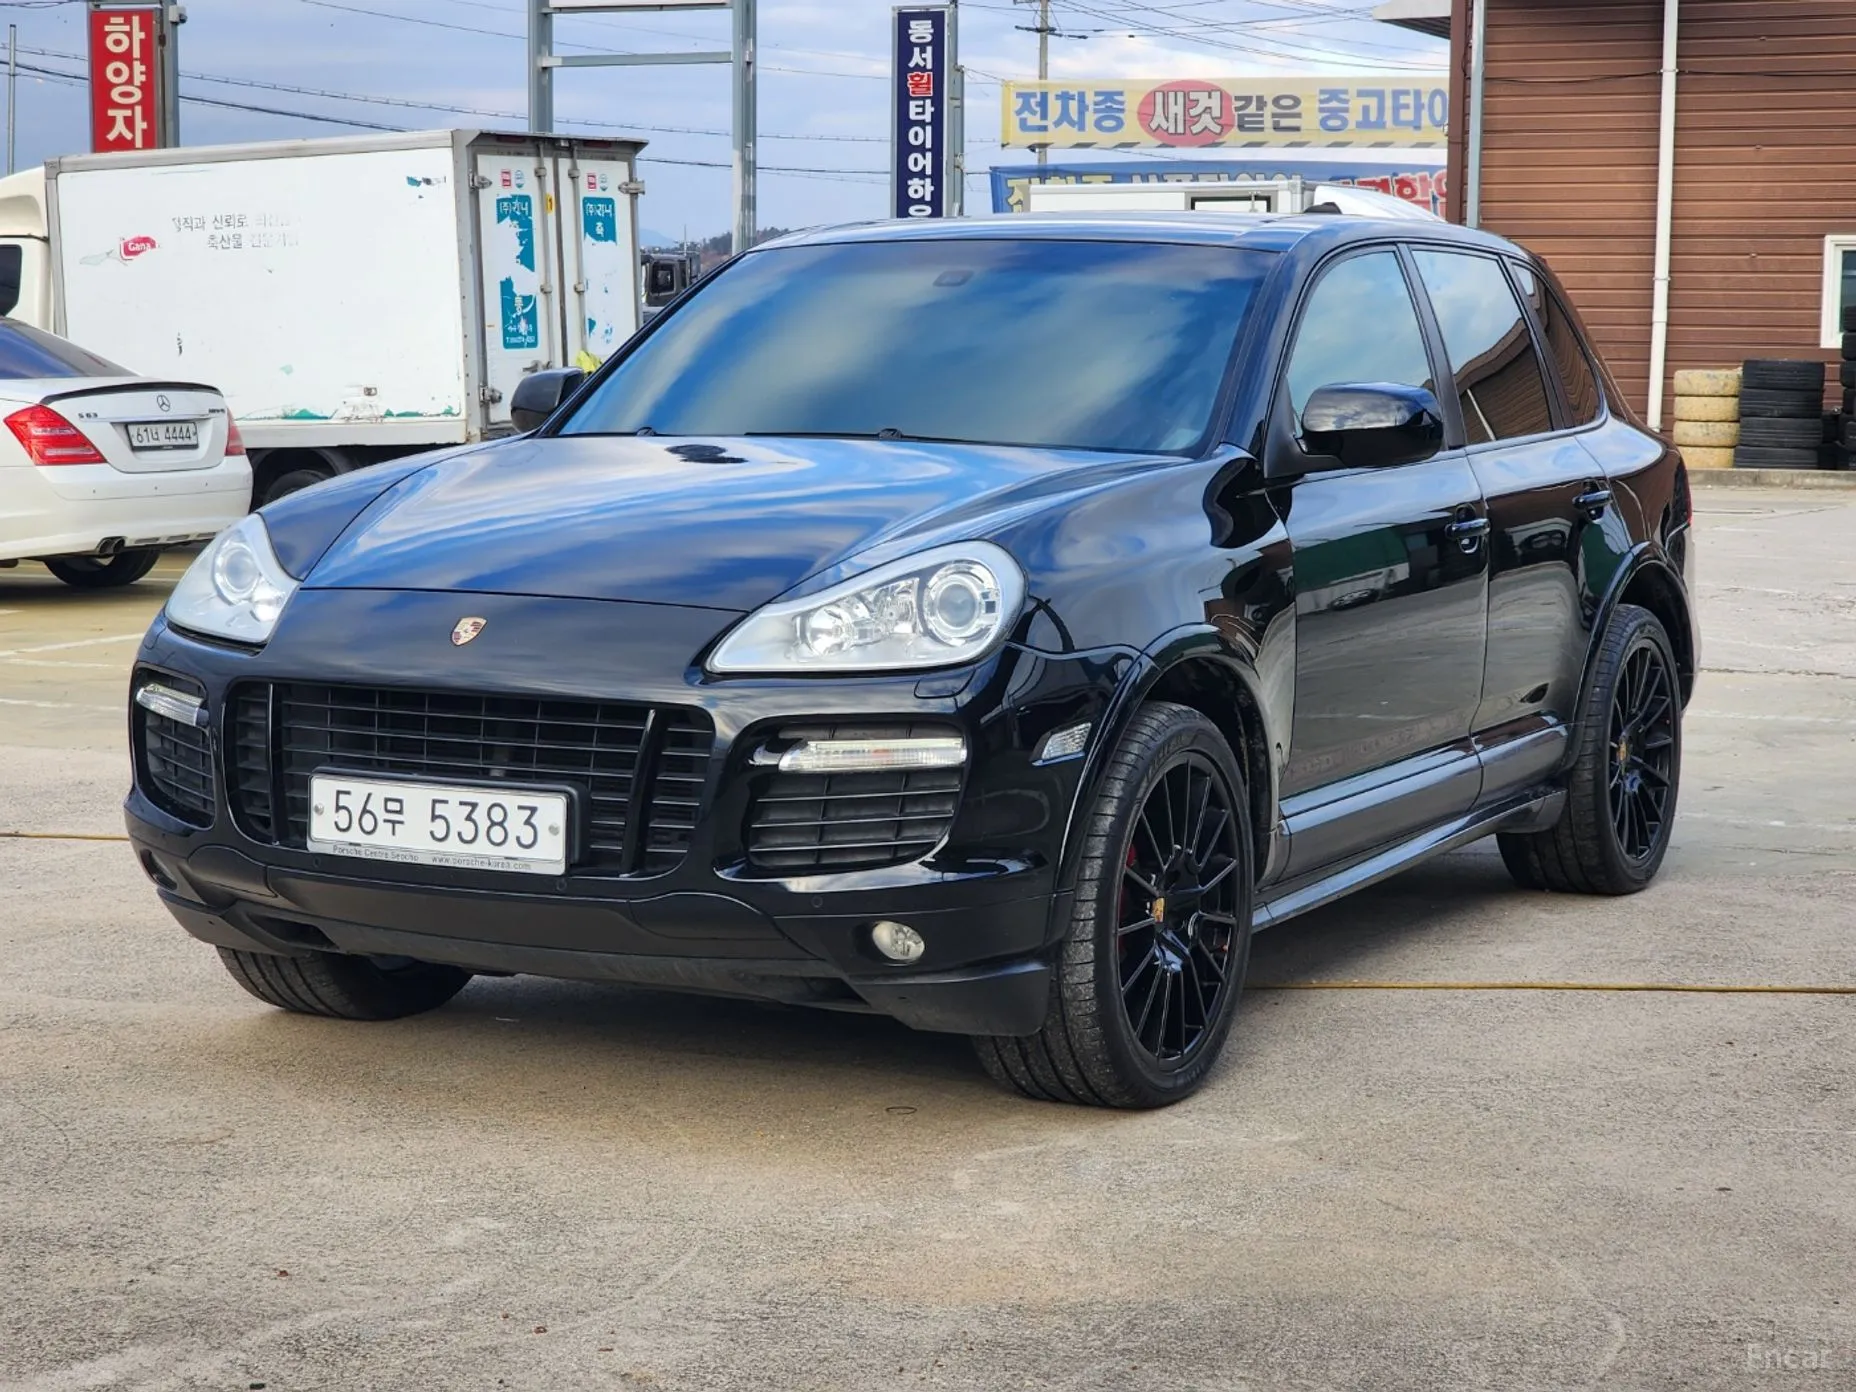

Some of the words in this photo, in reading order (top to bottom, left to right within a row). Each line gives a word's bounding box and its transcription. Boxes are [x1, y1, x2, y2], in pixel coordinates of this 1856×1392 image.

[104, 15, 148, 149] 하양자
[1015, 90, 1125, 133] 전차종
[1148, 90, 1223, 135] 새것
[1233, 94, 1302, 132] 같은
[164, 424, 192, 443] 4444
[334, 789, 405, 837] 56무
[429, 798, 539, 850] 5383
[332, 844, 362, 856] Porsche
